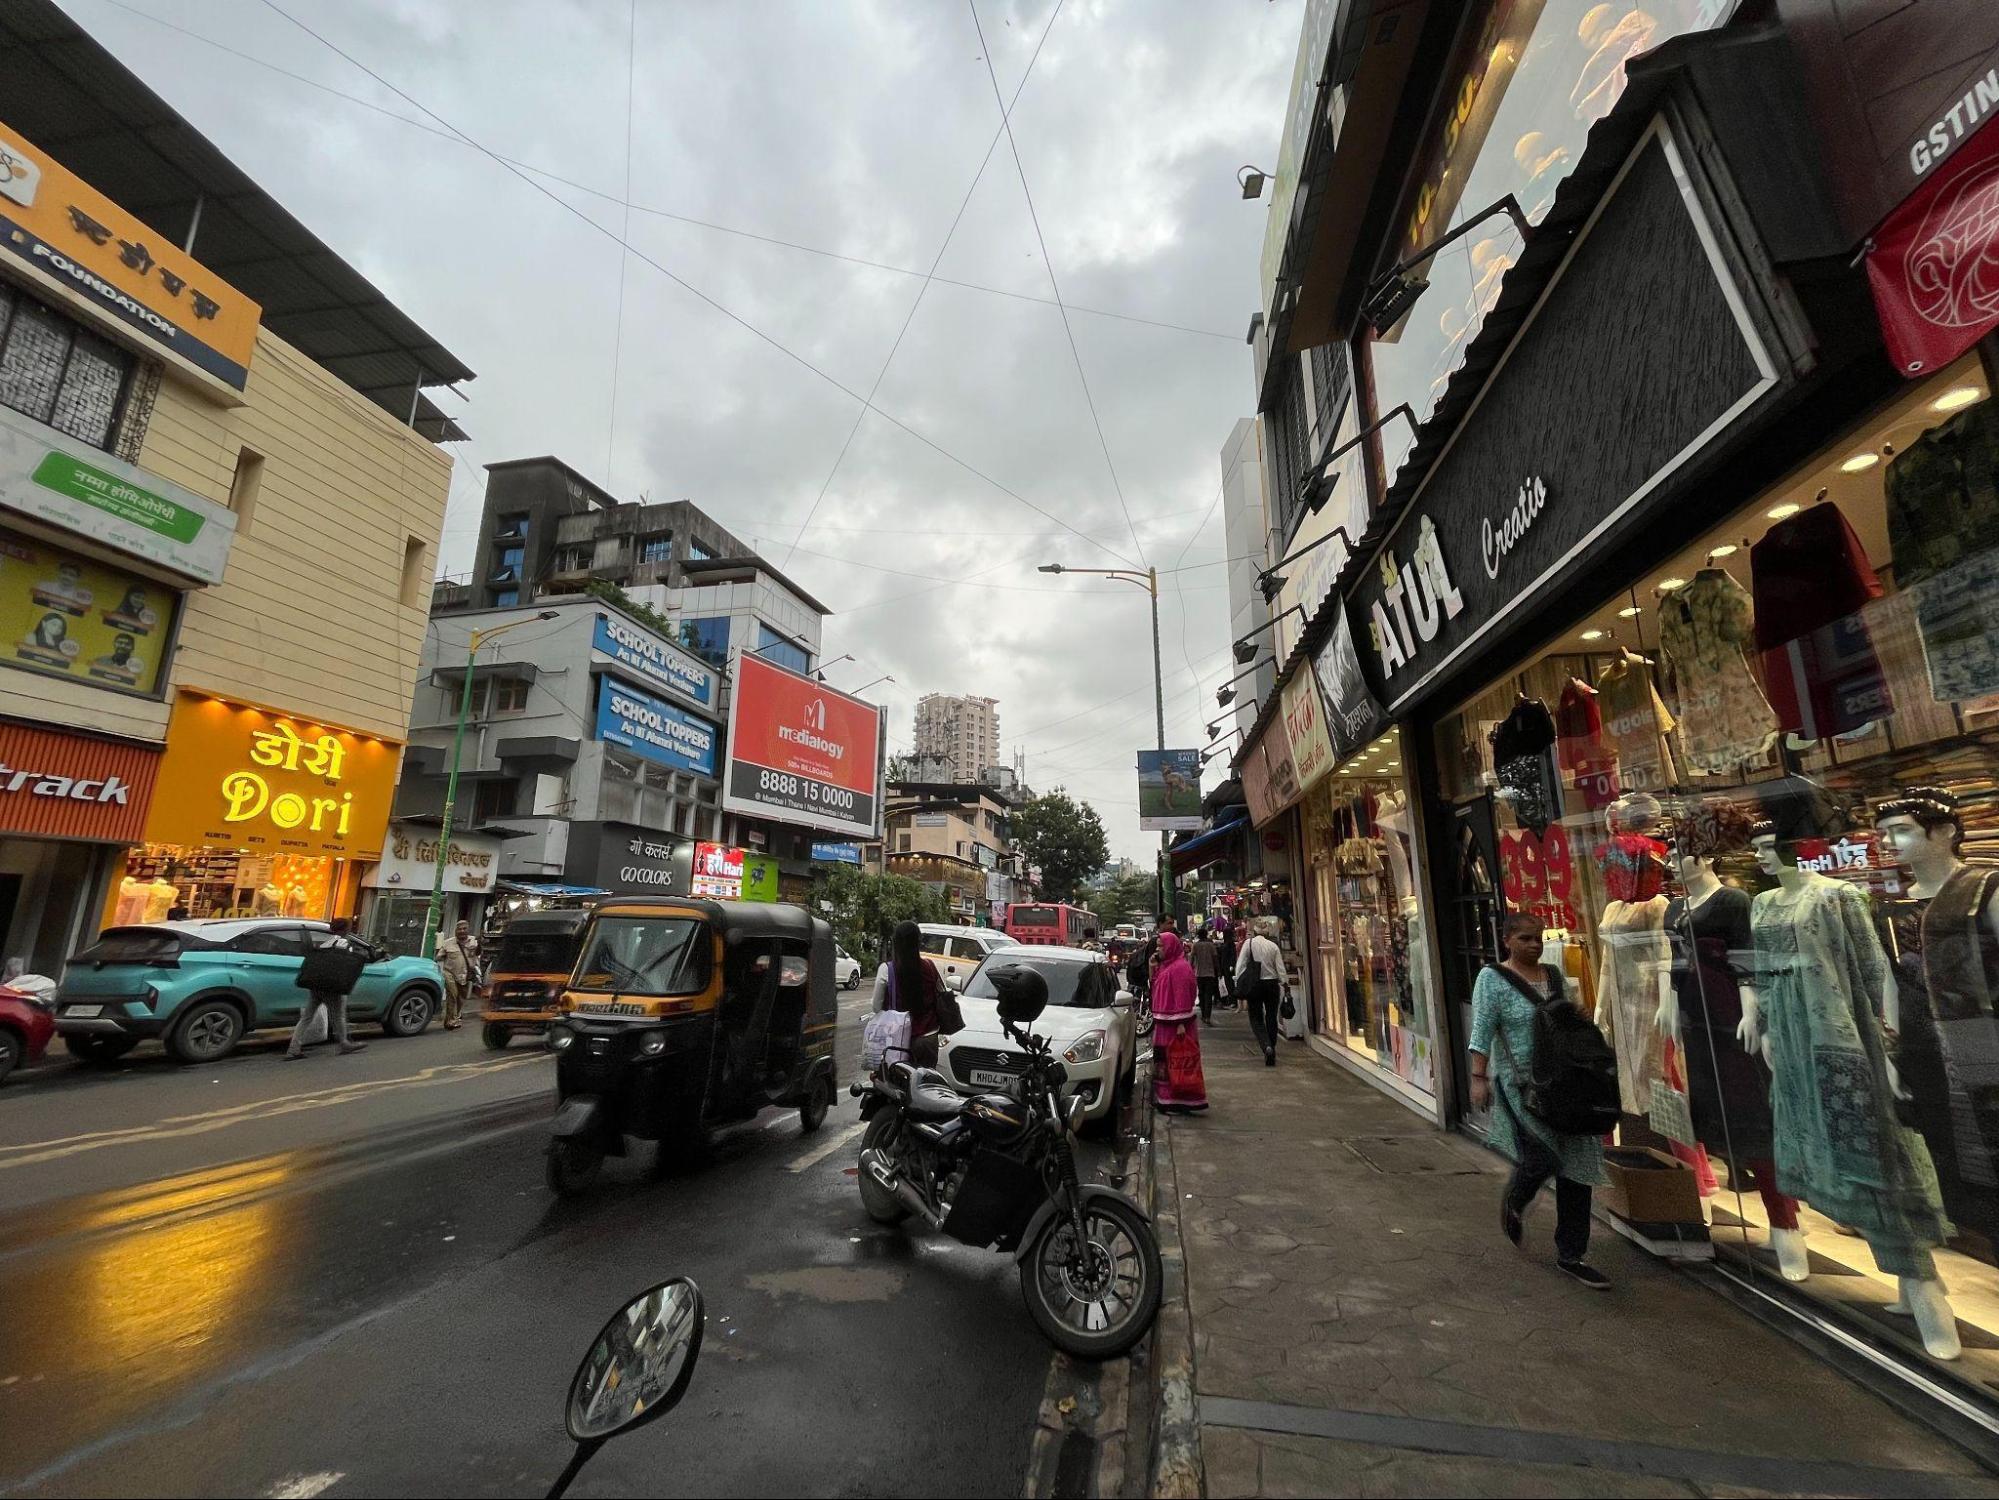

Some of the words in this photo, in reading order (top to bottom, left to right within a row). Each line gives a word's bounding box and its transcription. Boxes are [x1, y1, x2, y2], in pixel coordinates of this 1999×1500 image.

[1909, 69, 1999, 176] GSTIN
[33, 245, 176, 337] FOUNDATION
[1372, 528, 1464, 680] ATUL
[606, 621, 658, 663] SCHOOL
[658, 650, 705, 686] TOPPERS
[616, 647, 630, 662] An
[641, 658, 668, 683] Alumni
[668, 671, 696, 695] Venture
[610, 696, 663, 732] SCHOOL
[664, 715, 711, 750] TOPPERS
[621, 721, 634, 735] An
[645, 730, 673, 749] Alumni
[672, 739, 701, 760] Venture
[779, 725, 844, 760] medialogy
[250, 722, 347, 779] डोरी
[222, 771, 353, 834] Dori
[760, 770, 797, 795] 8888
[802, 781, 819, 800] 15
[822, 786, 853, 809] 0000
[629, 836, 643, 856] गो
[706, 848, 724, 875] हरी
[723, 861, 744, 878] Hari
[620, 866, 637, 883] GO
[637, 867, 673, 886] COLORS
